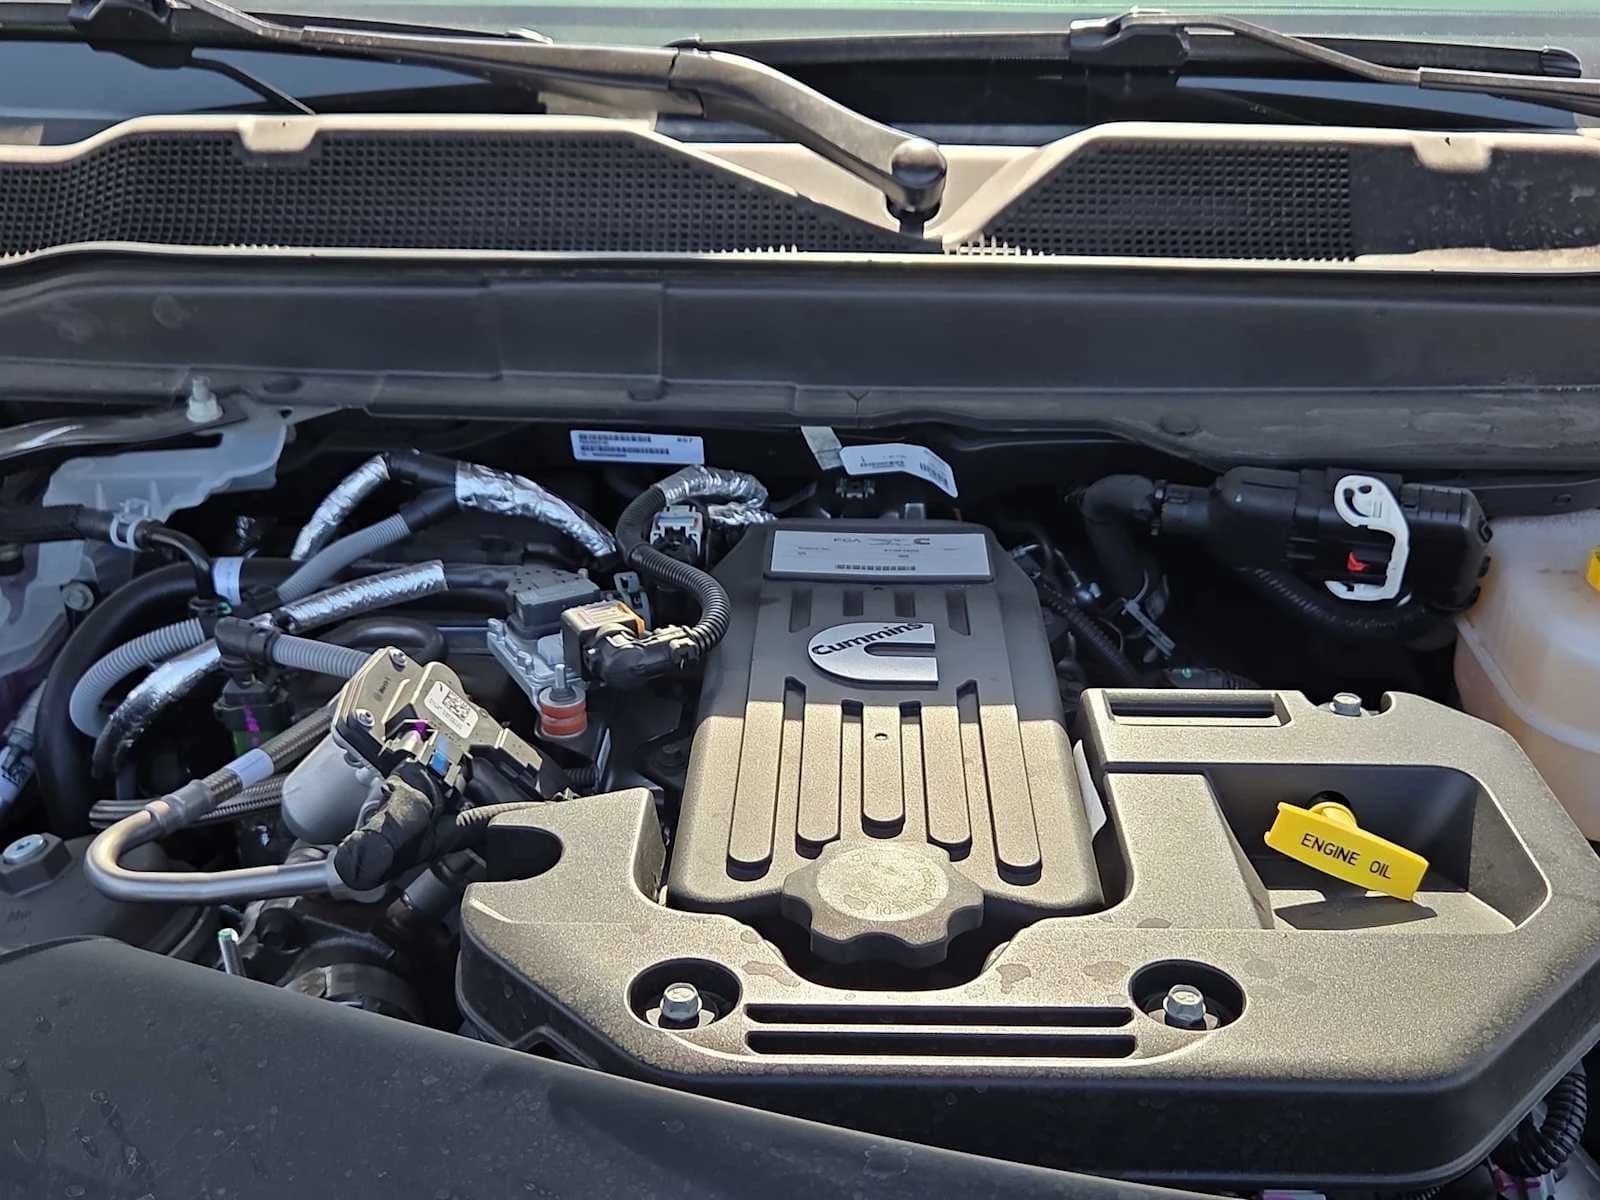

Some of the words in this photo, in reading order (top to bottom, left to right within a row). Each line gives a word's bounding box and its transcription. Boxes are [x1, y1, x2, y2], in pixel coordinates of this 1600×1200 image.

[811, 622, 924, 656] Cummins
[1301, 832, 1361, 867] ENGINE
[1369, 860, 1392, 880] OIL
